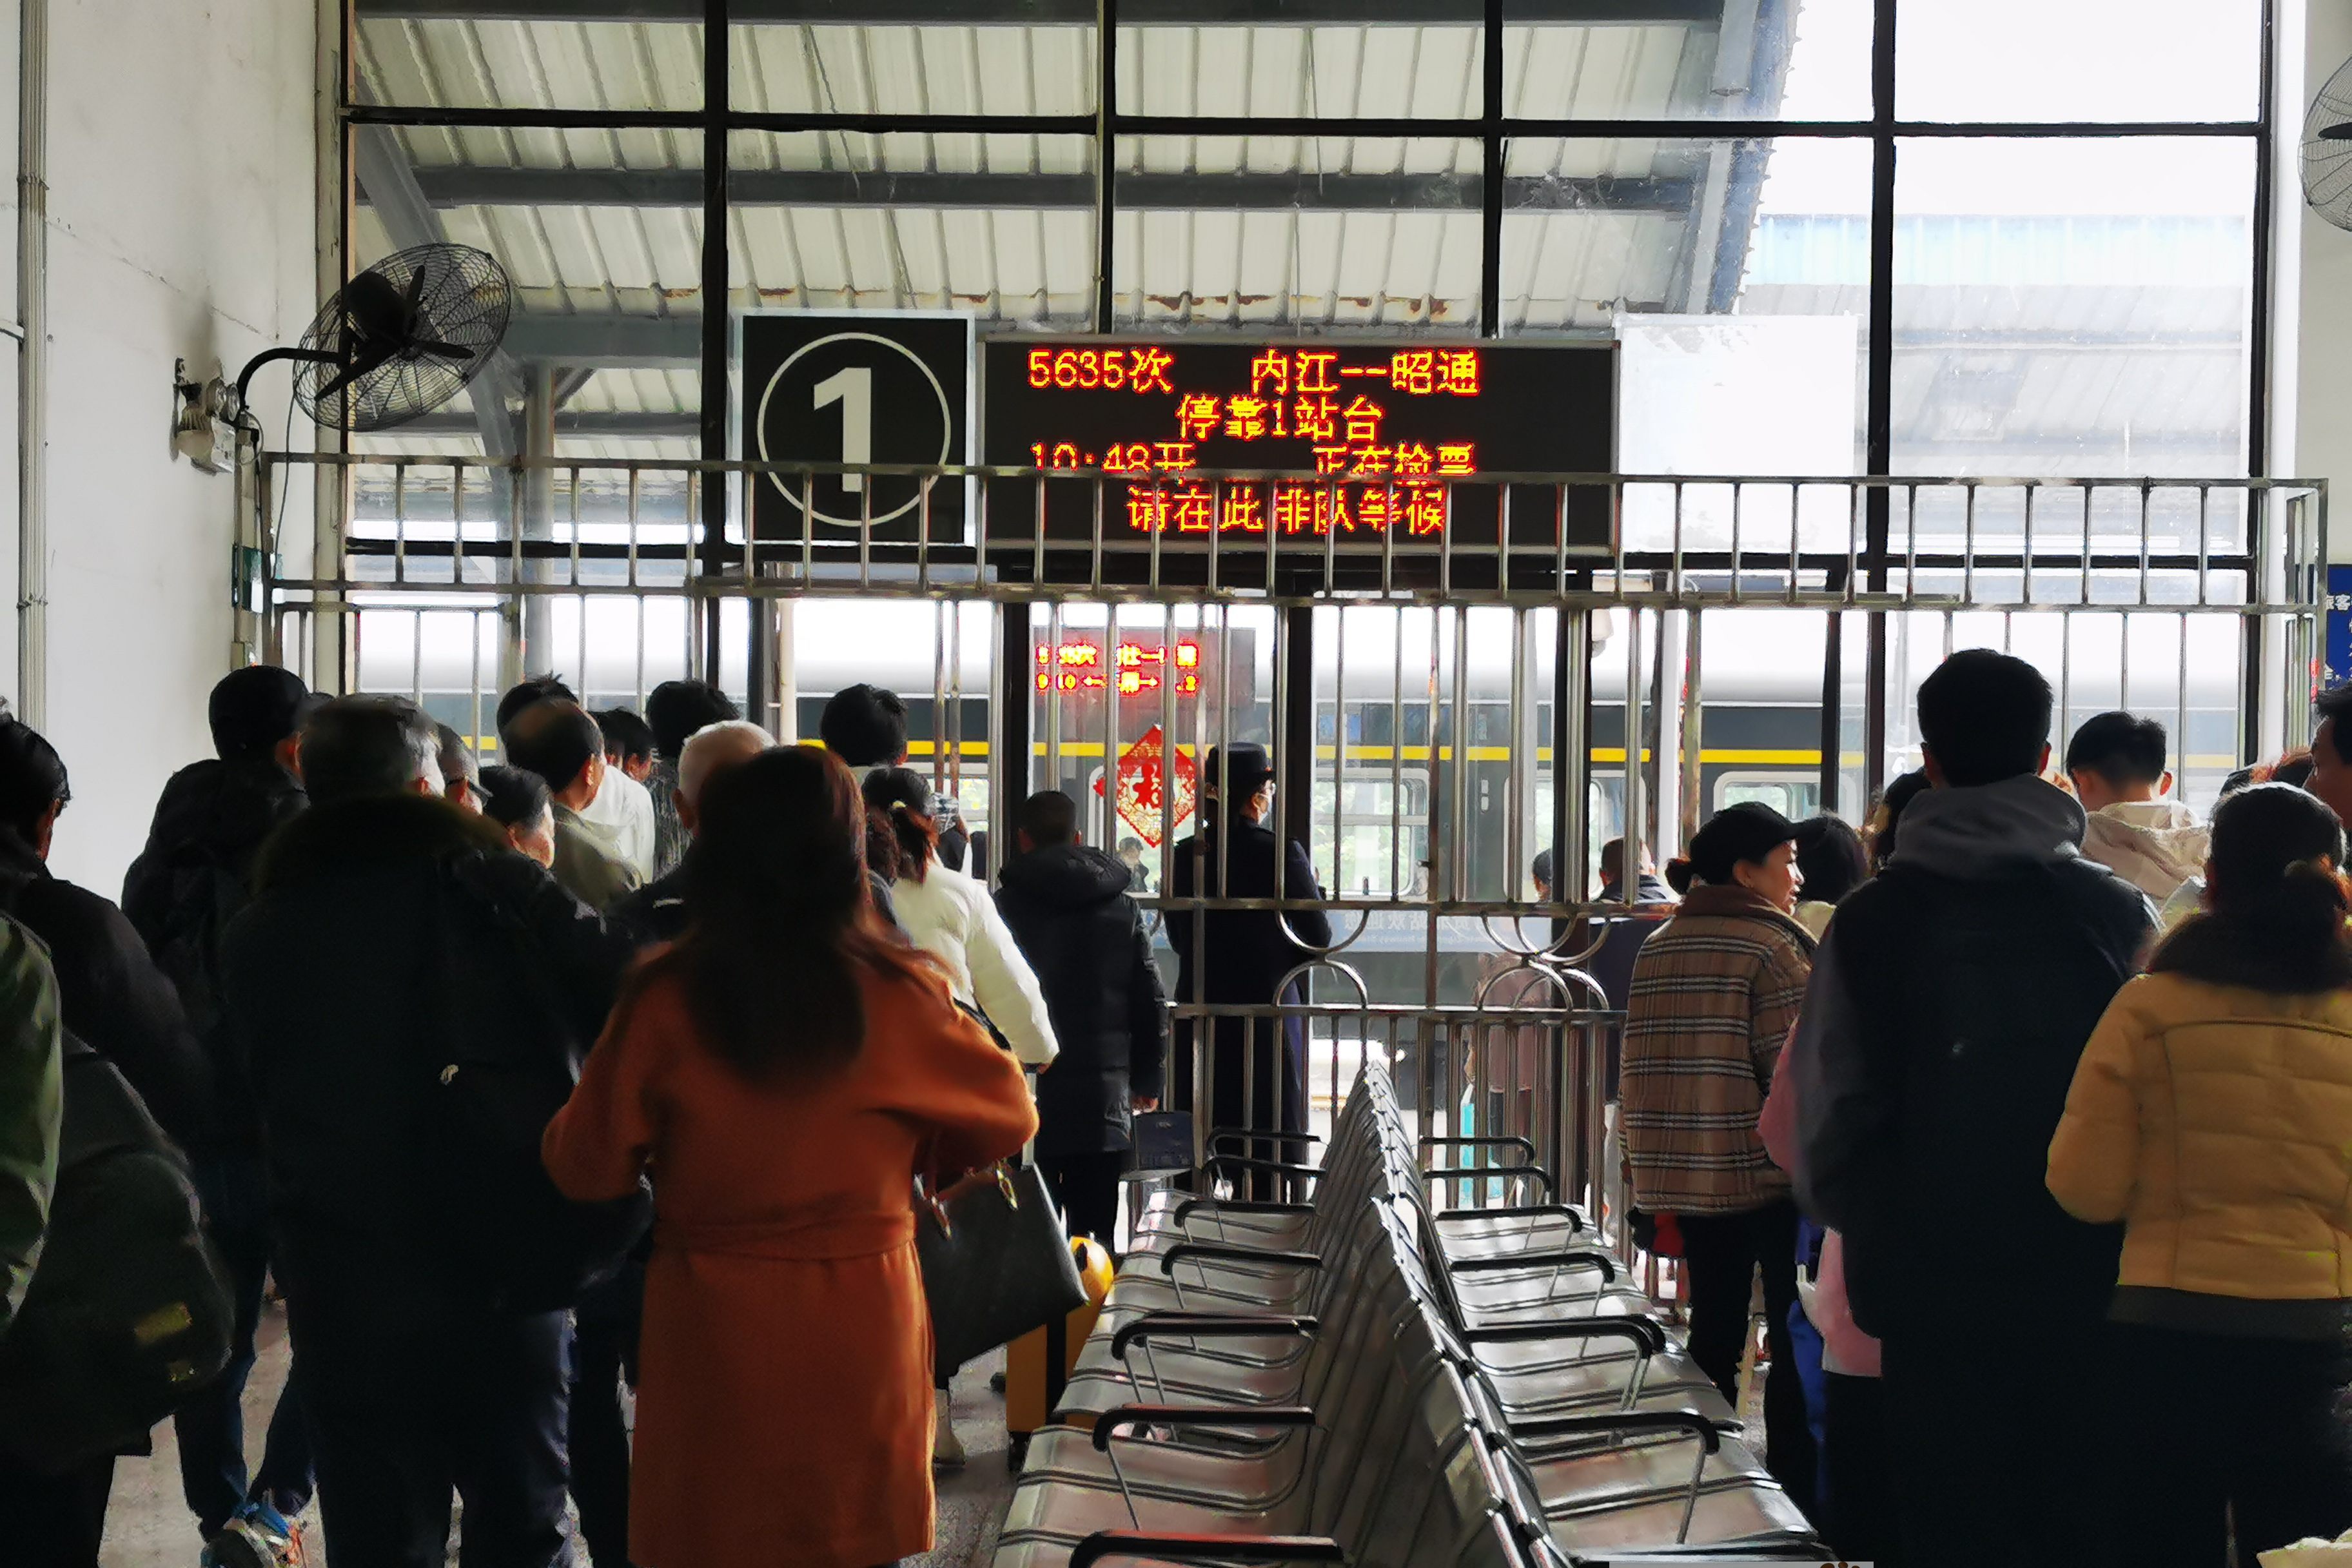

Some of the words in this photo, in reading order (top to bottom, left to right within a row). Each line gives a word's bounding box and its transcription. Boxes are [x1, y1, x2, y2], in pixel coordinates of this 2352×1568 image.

[1028, 347, 1173, 394] 5635次
[814, 368, 871, 492] 1
[1175, 395, 1385, 442] 停靠1站台
[1126, 485, 1447, 536] 请在此排队等候
